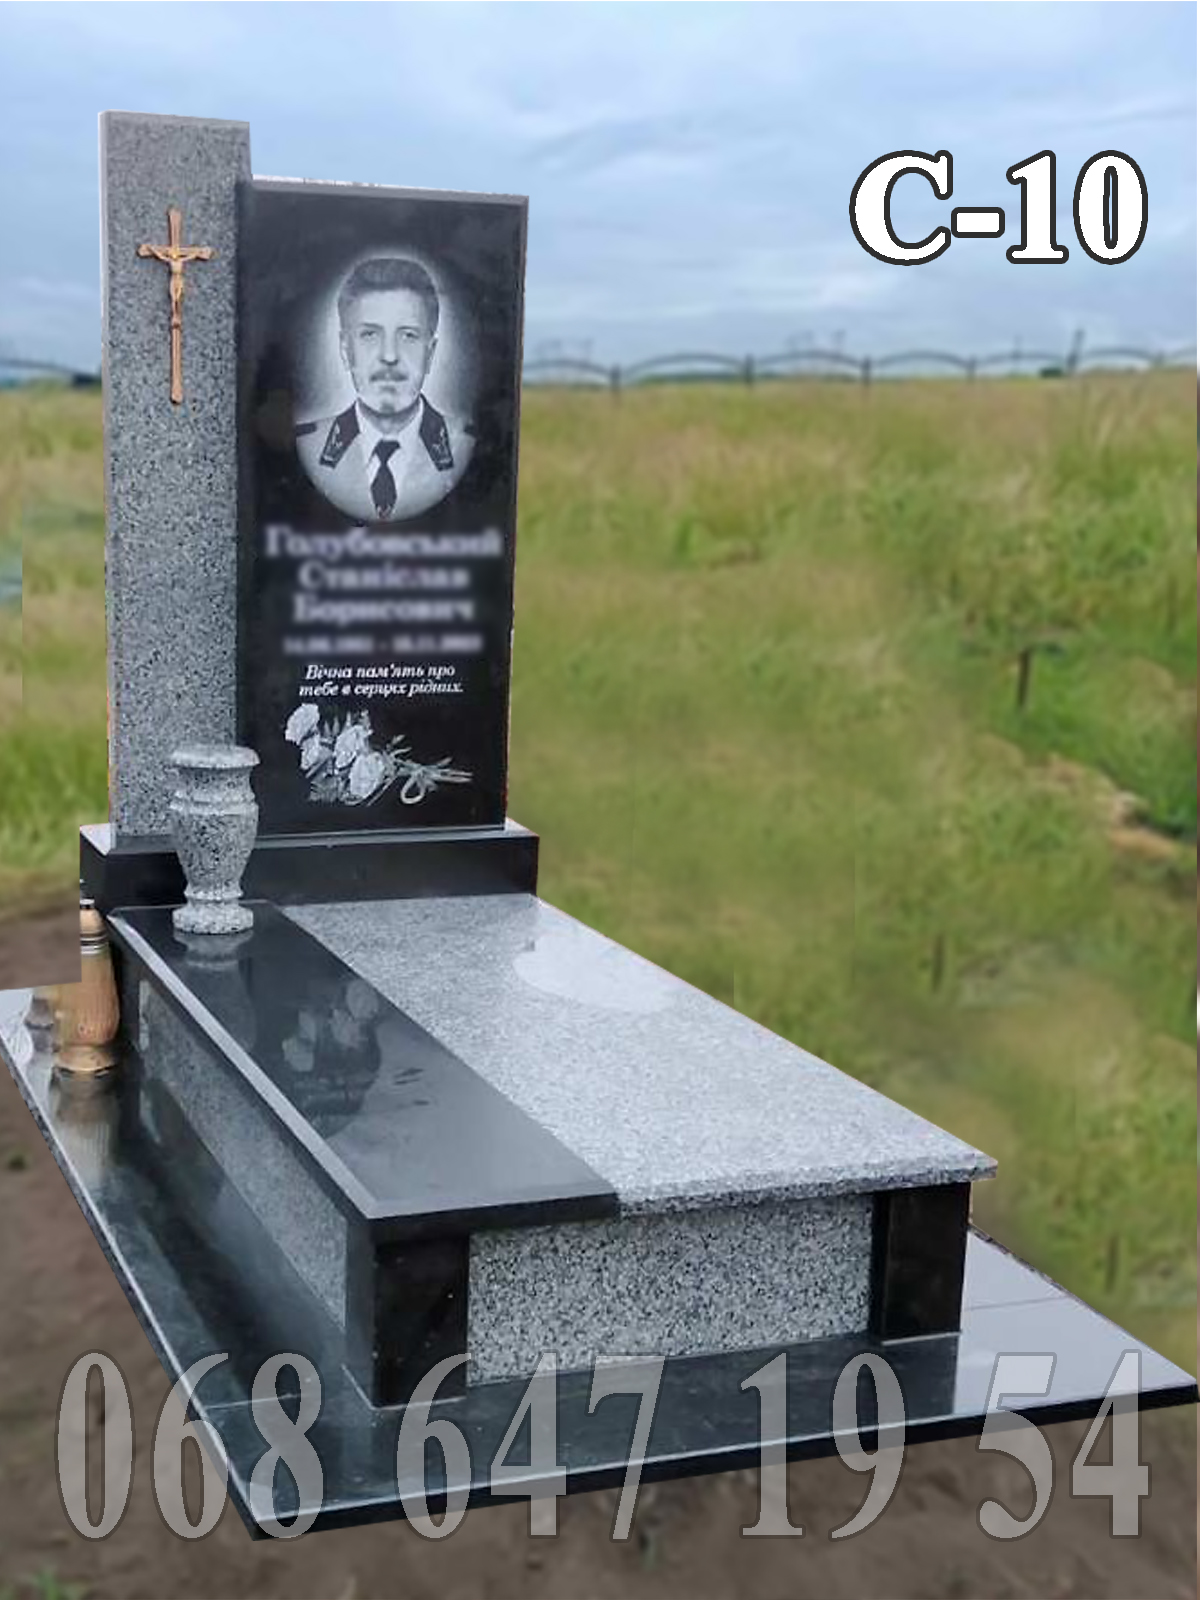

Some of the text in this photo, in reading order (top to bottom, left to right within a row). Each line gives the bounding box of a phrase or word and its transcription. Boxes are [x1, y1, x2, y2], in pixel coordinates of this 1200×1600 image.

[305, 664, 353, 680] Вічна
[427, 664, 456, 680] про
[299, 681, 340, 697] тебе
[354, 683, 408, 698] серцях
